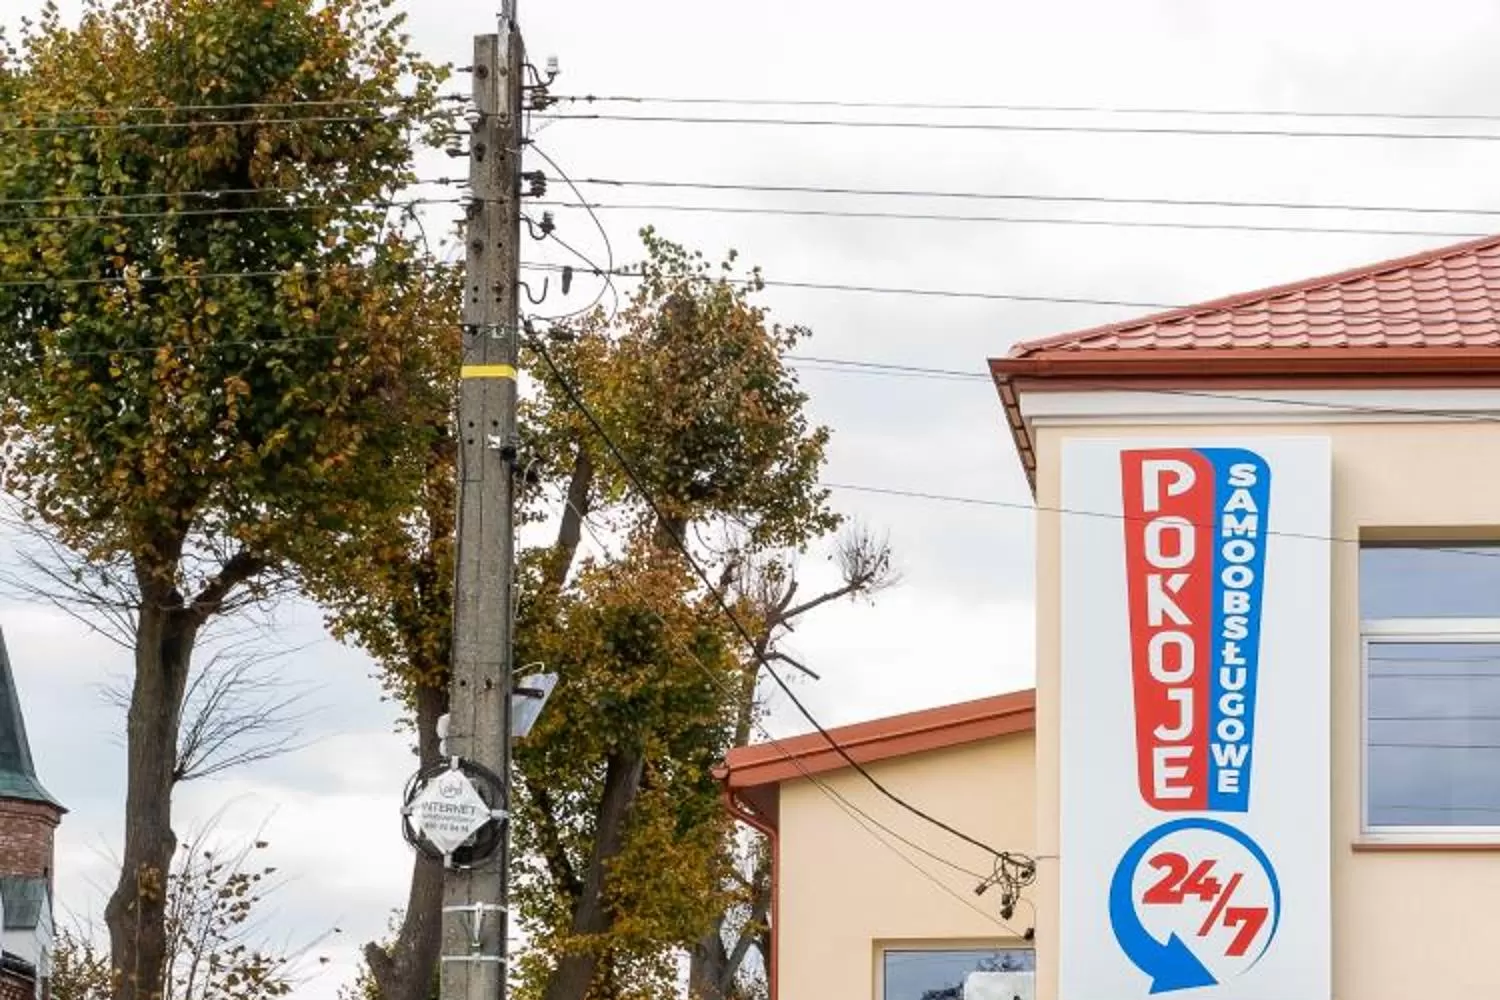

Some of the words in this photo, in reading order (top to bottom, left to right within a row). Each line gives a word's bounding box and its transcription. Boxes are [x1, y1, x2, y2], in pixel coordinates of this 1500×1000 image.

[1141, 459, 1196, 800] POKOJE
[1211, 462, 1258, 794] SAMOOBSŁUGOWE
[1142, 852, 1269, 957] 24/7
